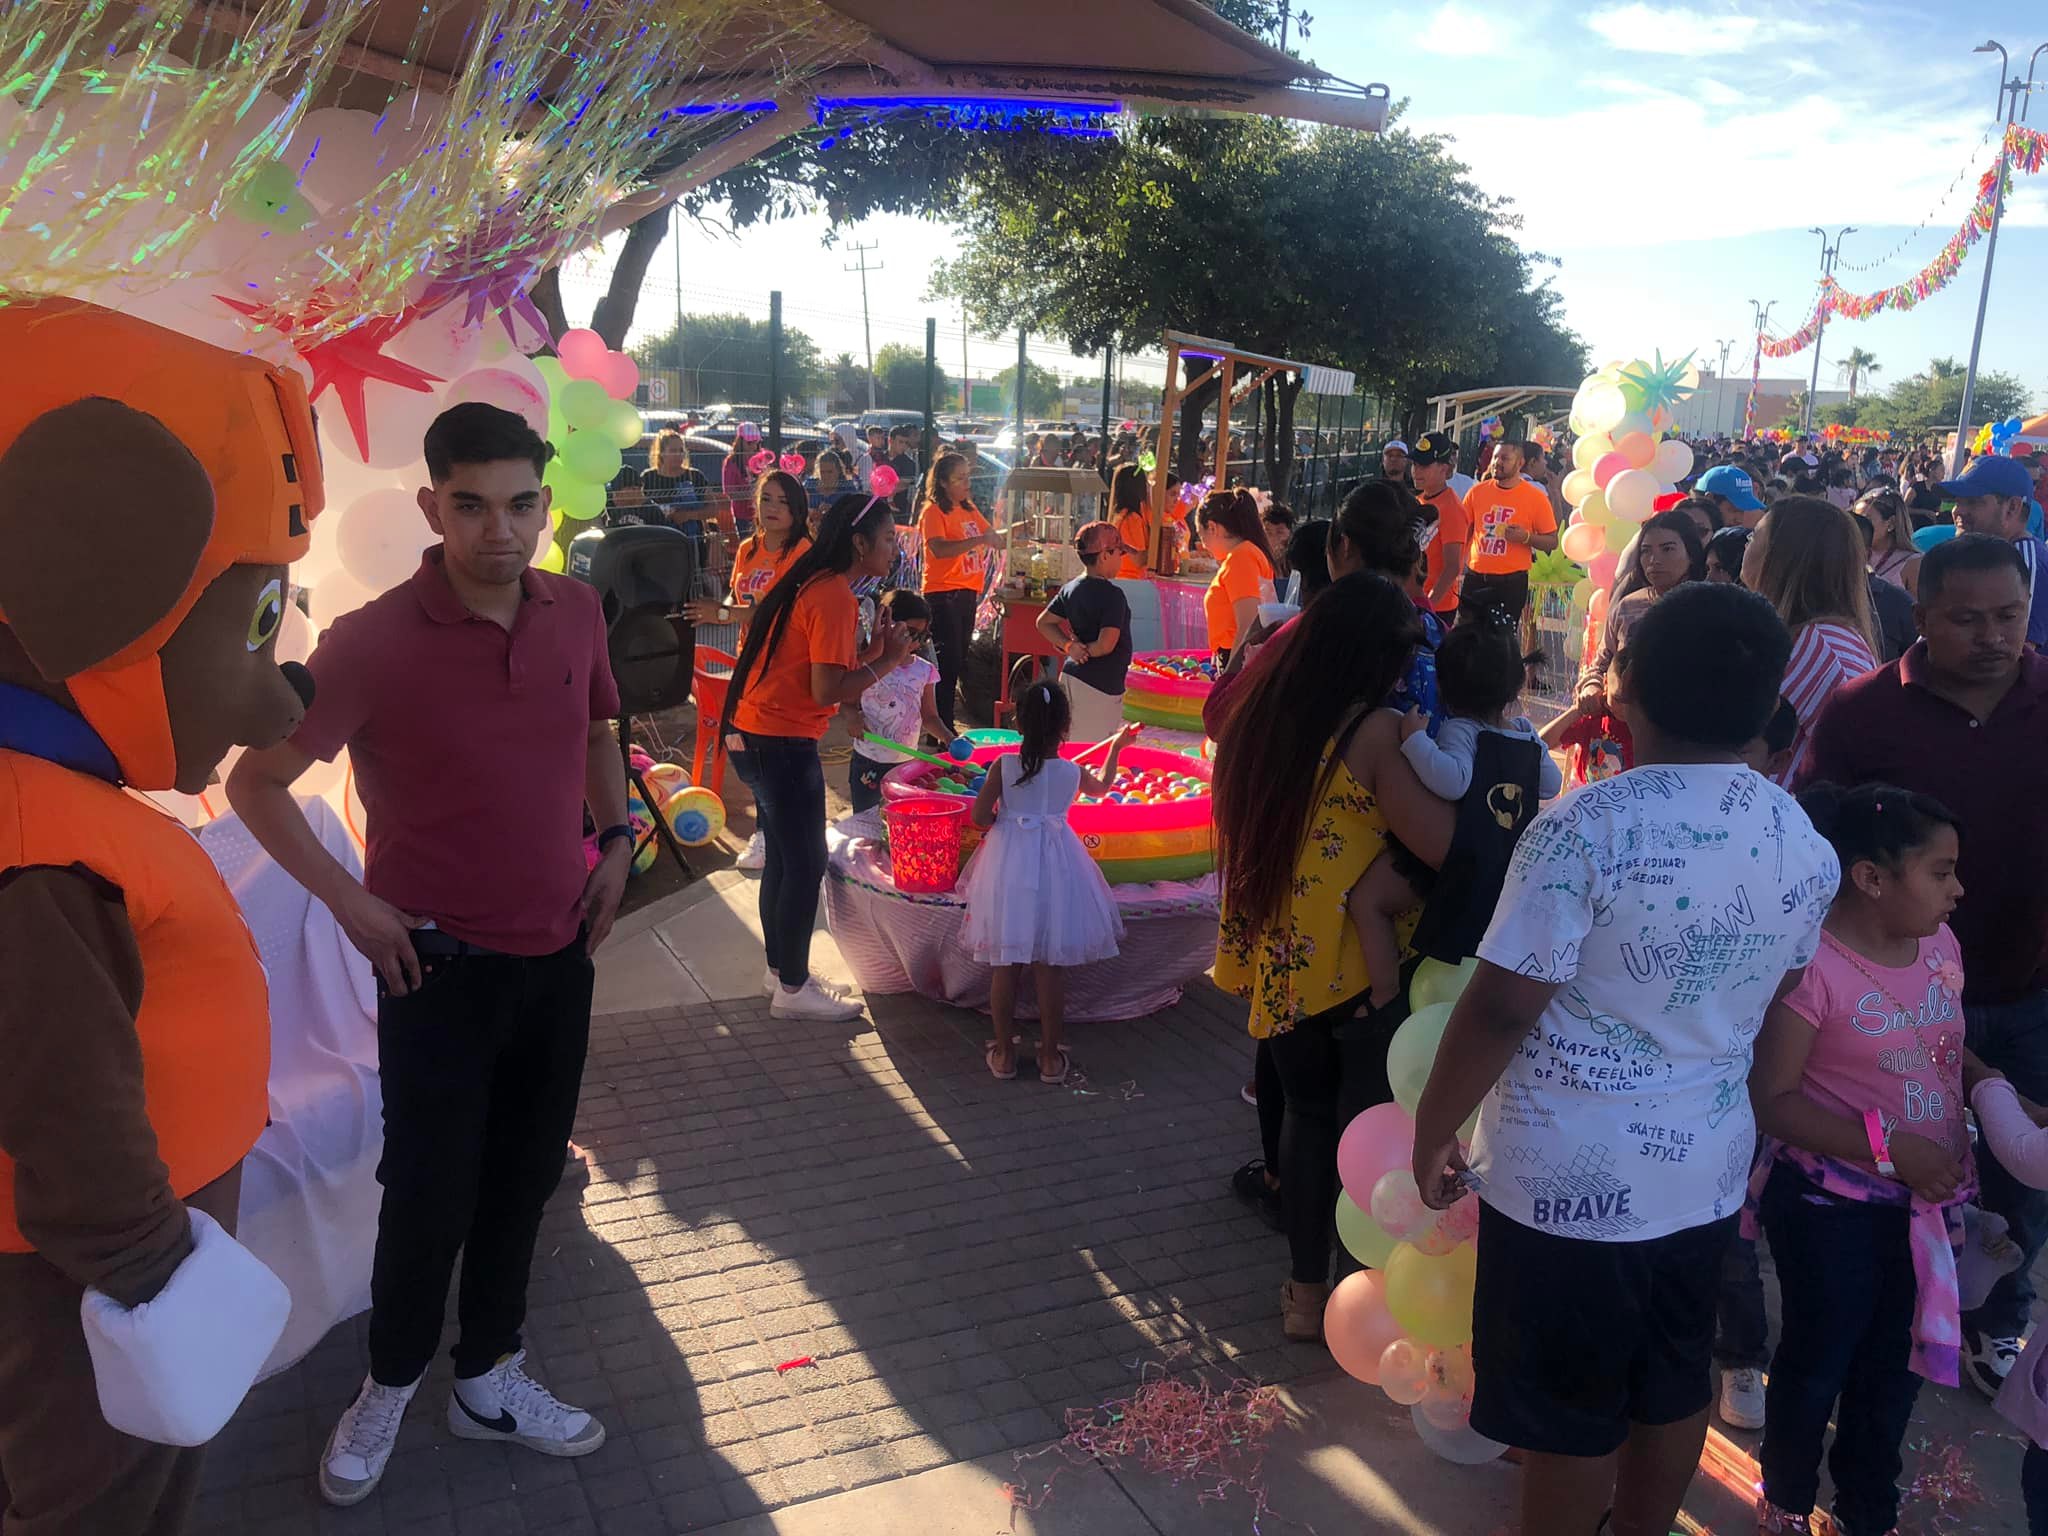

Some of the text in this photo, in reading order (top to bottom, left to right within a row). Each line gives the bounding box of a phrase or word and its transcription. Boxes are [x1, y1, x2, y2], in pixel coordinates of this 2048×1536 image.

[1619, 884, 1757, 984] URBAN
[1850, 984, 1956, 1037] Smile
[1547, 1033, 1621, 1063] SKATERS
[1879, 1036, 1929, 1073] and
[1534, 1067, 1637, 1092] OF SKATING
[1550, 1056, 1582, 1075] THE
[1589, 1063, 1654, 1081] FEELING
[1903, 1079, 1945, 1122] Be
[1626, 1121, 1695, 1146] SKATE RULE
[1639, 1142, 1688, 1163] STYLE
[1533, 1187, 1632, 1224] BRAVE
